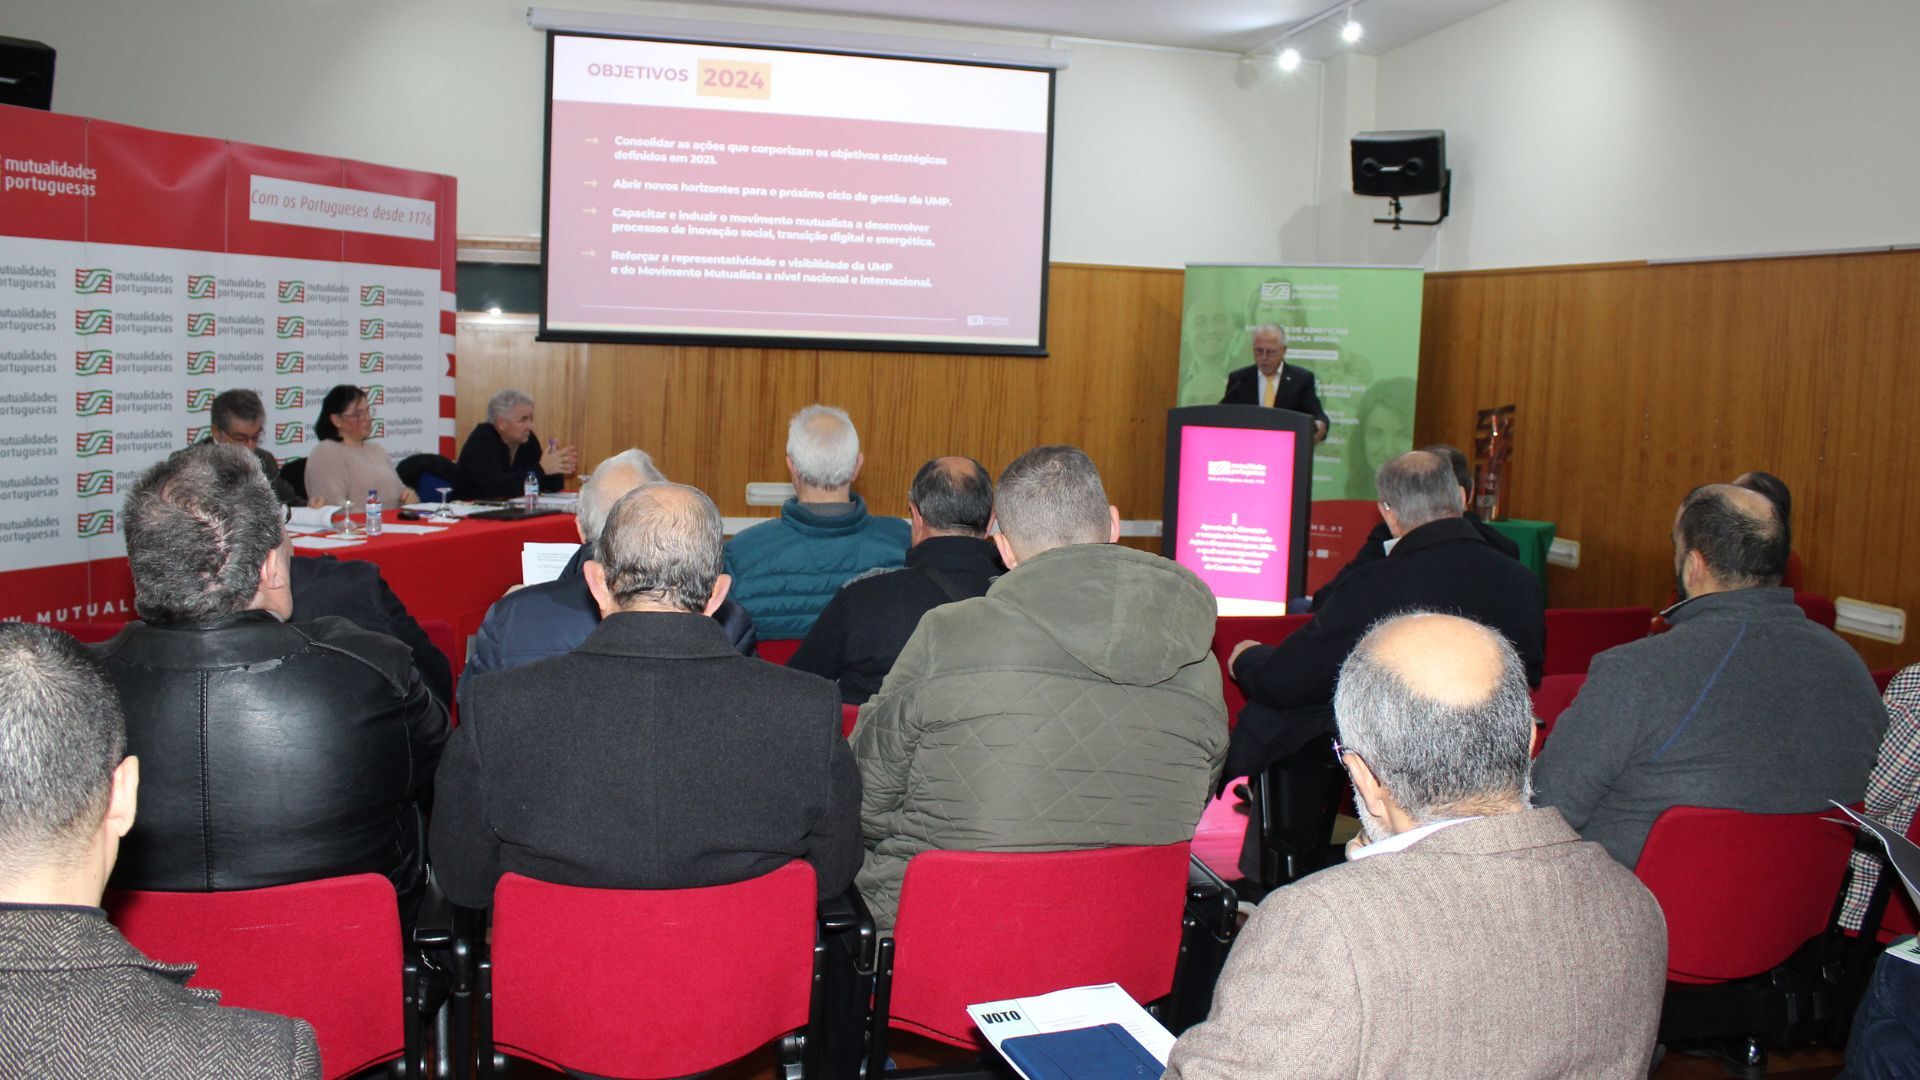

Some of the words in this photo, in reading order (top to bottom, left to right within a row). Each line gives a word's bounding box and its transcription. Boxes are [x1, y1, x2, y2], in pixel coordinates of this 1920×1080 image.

[588, 63, 688, 82] OBJETIVOS
[704, 68, 764, 90] 2024
[614, 136, 675, 148] Consolidar
[678, 141, 690, 150] as
[693, 141, 725, 152] ações
[728, 144, 748, 154] que
[752, 144, 813, 156] corporizam
[816, 149, 828, 157] os
[830, 148, 880, 160] objetivos
[882, 154, 947, 165] estratégicos
[614, 151, 667, 162] definidos
[669, 155, 688, 163] em
[690, 154, 717, 165] 2021.
[5, 158, 96, 180] mutualidades
[5, 176, 96, 196] portuguesas
[613, 179, 642, 190] Abrir
[644, 183, 678, 192] novos
[681, 182, 740, 194] horizontes
[742, 187, 767, 198] para
[769, 188, 777, 196] o
[779, 188, 824, 200] próximo
[827, 190, 852, 201] ciclo
[854, 192, 868, 202] de
[870, 193, 907, 205] gestão
[909, 194, 922, 205] da
[924, 196, 952, 206] UMP.
[251, 189, 278, 206] Com
[282, 196, 296, 208] os
[300, 196, 368, 218] Portugueses
[372, 205, 404, 221] desde
[408, 211, 432, 226] 1176
[612, 208, 666, 220] Capacitar
[669, 212, 676, 220] e
[678, 210, 718, 222] induzir
[720, 214, 728, 222] o
[730, 213, 793, 226] movimento
[795, 218, 853, 229] mutualista
[864, 220, 930, 232] desenvolver
[612, 222, 669, 234] processos
[671, 225, 686, 234] de
[688, 224, 738, 238] inovação
[740, 228, 775, 240] social,
[777, 230, 828, 243] transição
[830, 232, 864, 244] digital
[875, 236, 935, 247] energética.
[611, 250, 660, 263] Reforçar
[662, 254, 668, 262] a
[672, 254, 776, 267] representatividade
[788, 258, 849, 270] visibilidade
[852, 261, 864, 270] da
[868, 262, 892, 272] UMP
[0, 264, 56, 277] utualidades
[620, 265, 636, 274] do
[638, 266, 702, 278] Movimento
[704, 268, 762, 280] Mutualista
[774, 272, 801, 282] nível
[803, 273, 848, 284] nacional
[852, 276, 858, 284] e
[860, 274, 932, 287] internacional.
[115, 272, 173, 284] mutualidades
[218, 278, 265, 288] mutualidades
[0, 278, 56, 290] ortuguesas
[306, 282, 349, 293] mutualidades
[115, 284, 172, 296] portuguesas
[218, 289, 264, 300] portuguesas
[306, 294, 348, 304] portuguesas
[0, 308, 56, 318] utualidades
[115, 312, 173, 322] mutualidades
[218, 315, 264, 325] mutualidades
[306, 318, 349, 327] mutualidades
[0, 320, 56, 333] ortuguesas
[115, 324, 172, 335] portuguesas
[218, 326, 264, 336] portuguesas
[306, 328, 348, 339] portuguesas
[0, 350, 57, 360] utualidades
[115, 350, 173, 361] mutualidades
[218, 351, 264, 361] mutualidades
[306, 352, 349, 361] mutualidades
[0, 363, 56, 375] ortuguesas
[115, 363, 172, 374] portuguesas
[218, 362, 263, 374] portuguesas
[306, 363, 348, 372] portuguesas
[0, 392, 57, 403] utualidades
[115, 390, 173, 400] mutualidades
[0, 404, 56, 418] ortuguesas
[115, 402, 172, 413] portuguesas
[115, 428, 173, 440] mutualidades
[115, 442, 172, 453] portuguesas
[1311, 524, 1343, 532] MO.PT
[37, 598, 128, 623] MUTUAL
[981, 1010, 1021, 1024] VOTO
